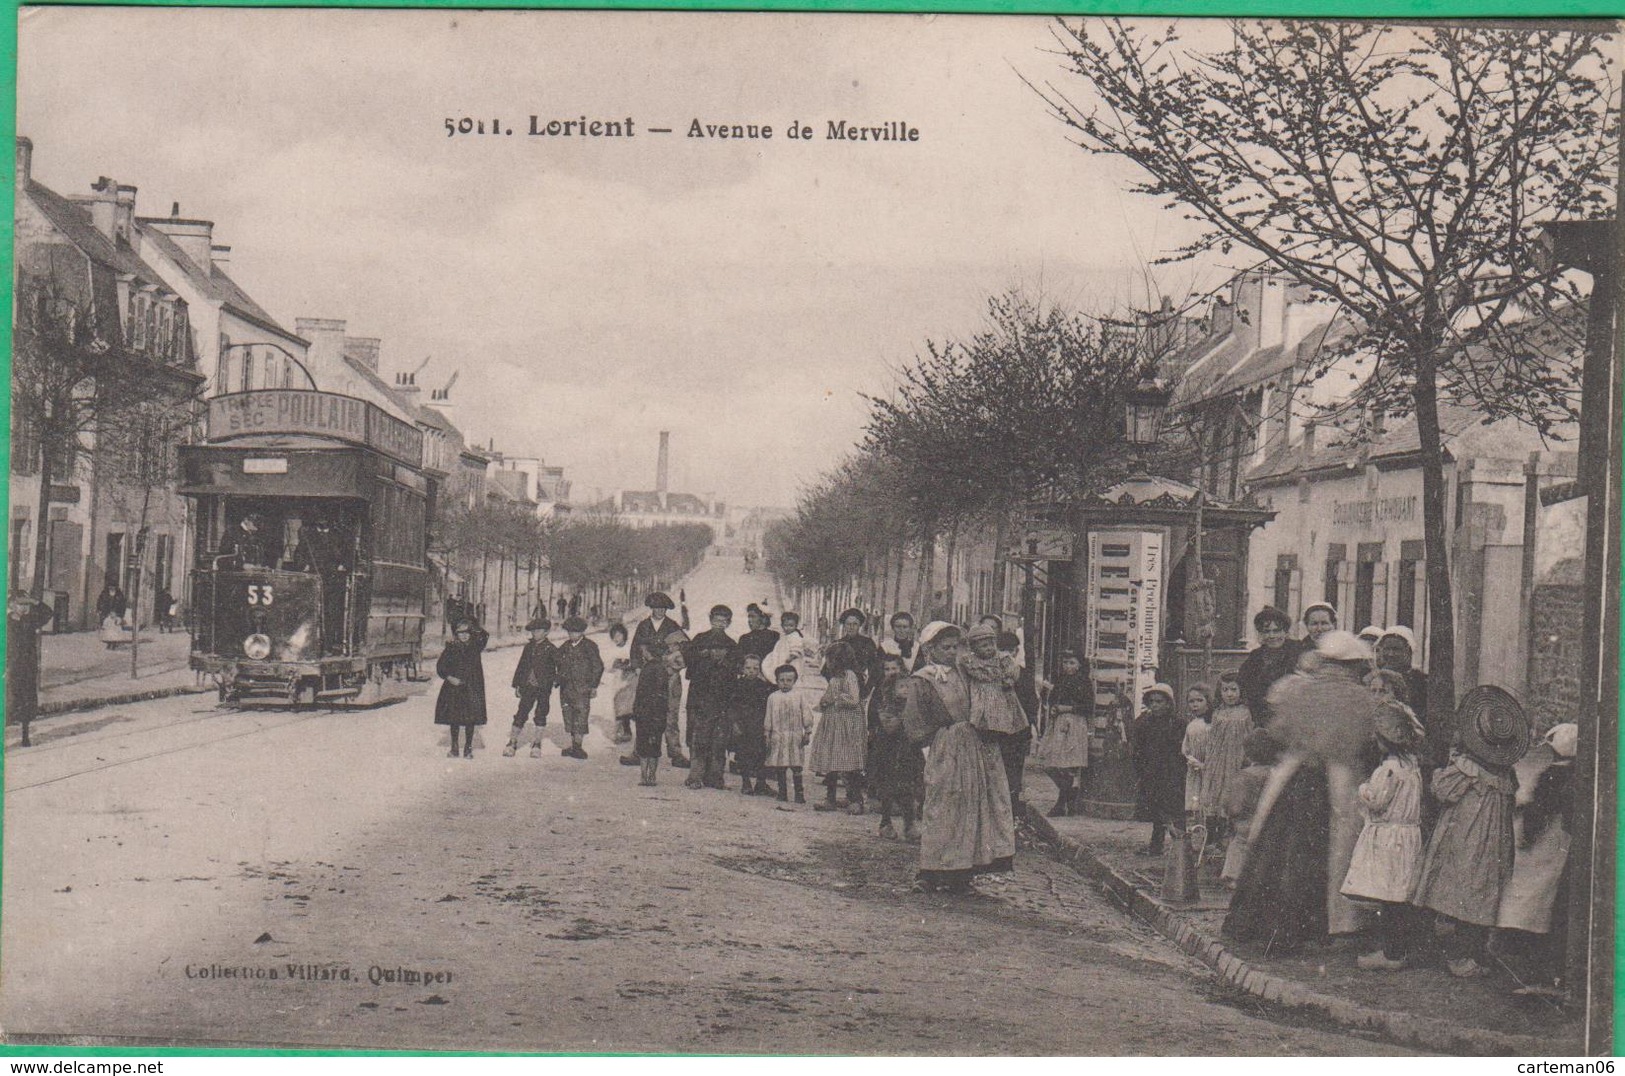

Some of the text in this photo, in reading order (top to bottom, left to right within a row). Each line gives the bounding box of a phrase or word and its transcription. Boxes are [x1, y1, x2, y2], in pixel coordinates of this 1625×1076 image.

[217, 393, 274, 414] TRIPLE
[277, 393, 360, 434] POULAIN
[230, 411, 265, 429] SEC
[248, 585, 273, 606] 53
[1129, 588, 1138, 629] GRAND
